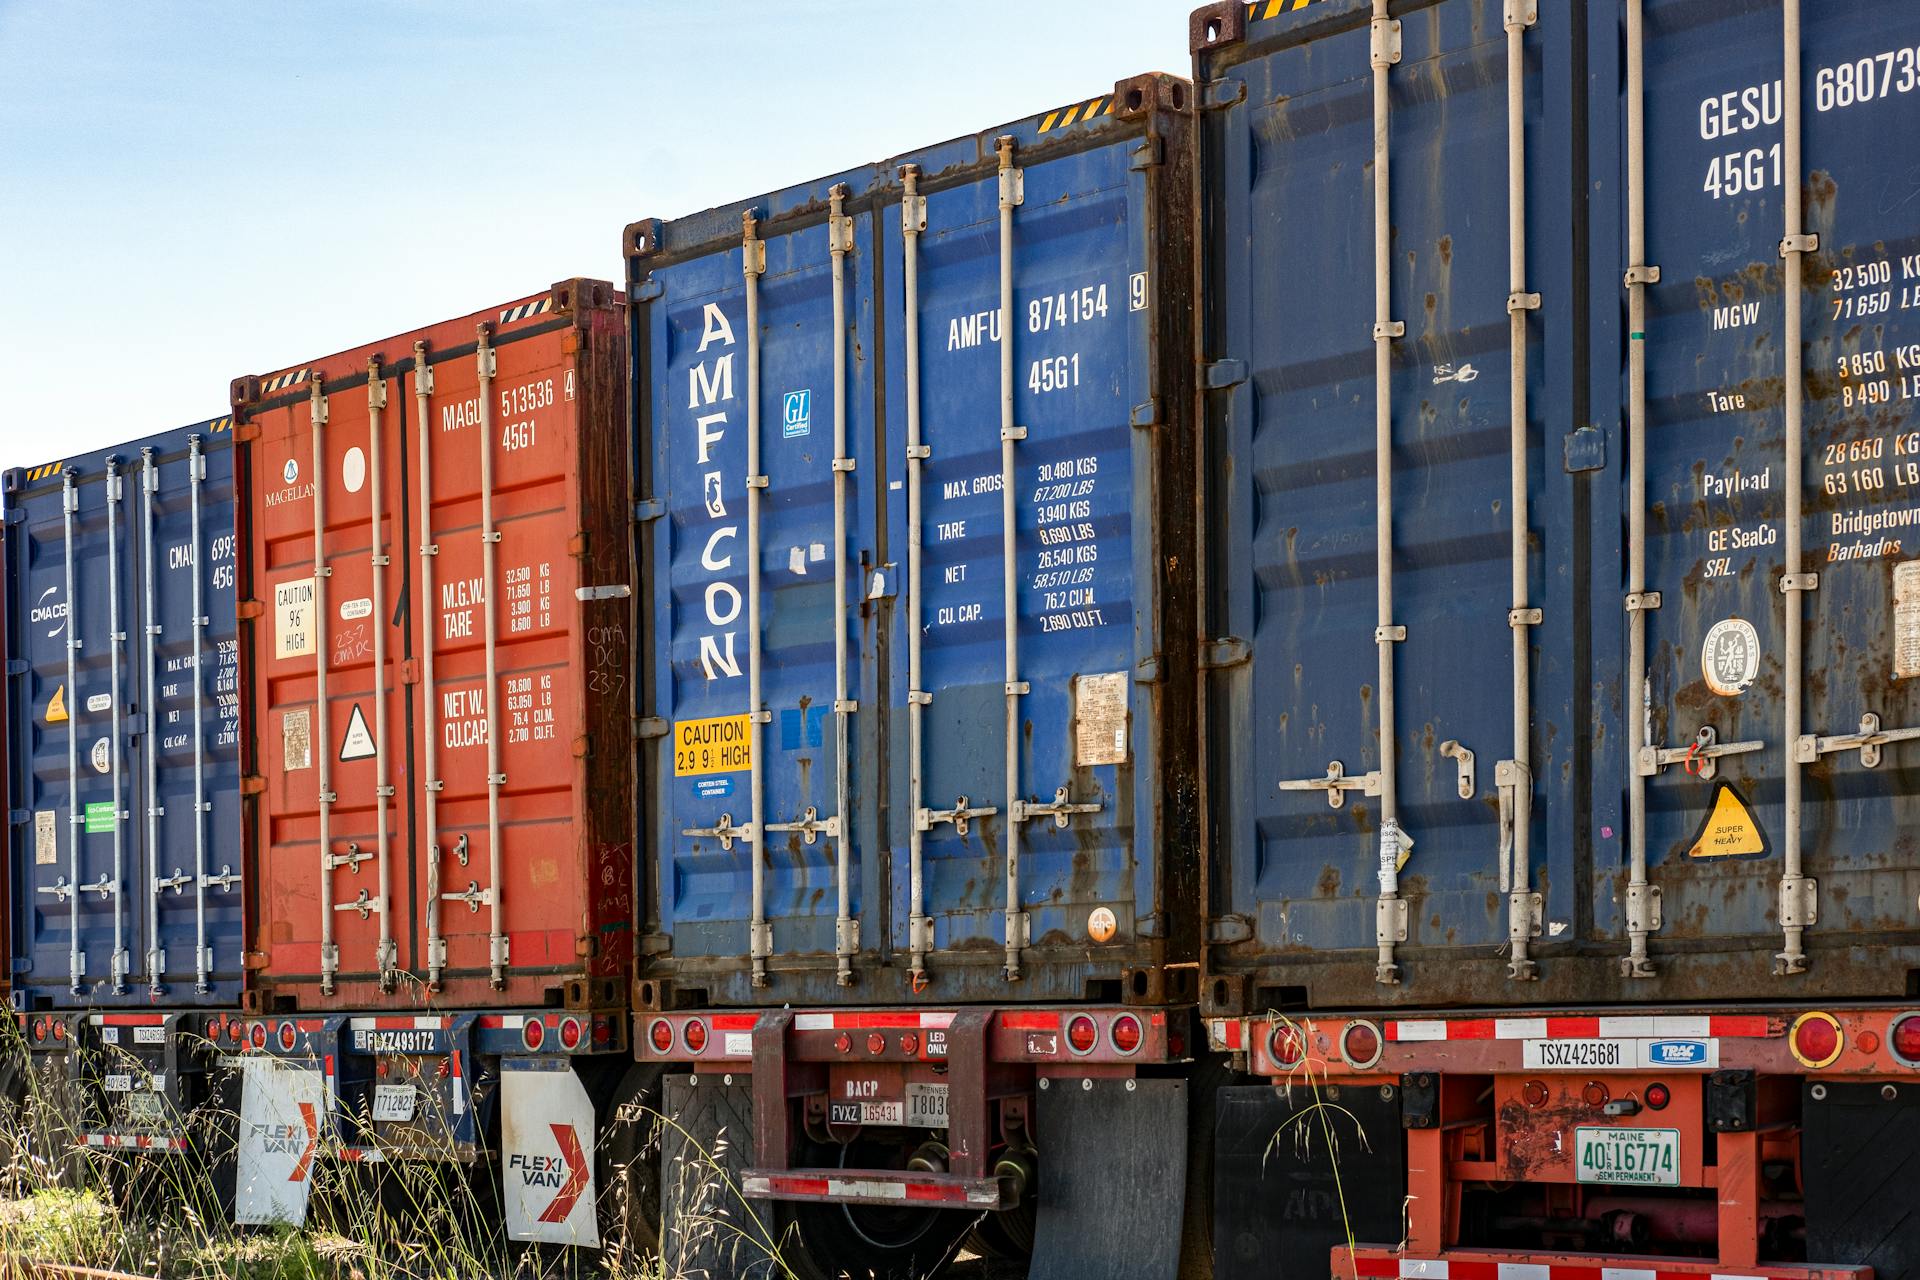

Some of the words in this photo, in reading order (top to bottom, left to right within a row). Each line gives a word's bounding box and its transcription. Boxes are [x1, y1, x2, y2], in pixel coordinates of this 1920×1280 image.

[1700, 79, 1782, 140] GESU
[1816, 47, 1920, 112] 68073
[1704, 143, 1781, 199] 45G1
[948, 309, 1002, 351] AMFU
[1029, 284, 1108, 333] 874154
[1132, 274, 1146, 309] 9
[1713, 302, 1760, 330] MGW
[1029, 353, 1079, 394] 45G1
[442, 397, 482, 432] MAGU
[501, 379, 553, 417] 513536
[565, 371, 575, 398] 4
[786, 393, 808, 423] GL
[1707, 391, 1745, 413] Tare
[502, 419, 536, 451] 45G1
[1895, 432, 1920, 456] KG
[1076, 457, 1097, 475] KGS
[1895, 462, 1920, 486] LB
[265, 482, 316, 507] MAGELLAN
[944, 480, 971, 500] MAX.
[1071, 479, 1095, 496] LBS
[1069, 500, 1090, 519] KGS
[938, 521, 966, 540] TARE
[1071, 522, 1095, 541] LBS
[1832, 508, 1920, 536] Bridgetown
[1709, 529, 1728, 552] GE
[1731, 524, 1777, 549] SeaCo
[169, 543, 194, 569] CMAU
[1076, 545, 1097, 563] KGS
[1827, 536, 1901, 562] Barbados
[506, 566, 530, 584] 32.500
[539, 563, 550, 577] KG
[945, 565, 967, 583] NET
[1071, 567, 1094, 584] LBS
[1704, 557, 1736, 578] SRL.
[213, 565, 236, 590] 45G
[278, 584, 312, 607] CAUTION
[443, 577, 485, 609] M.G.W.
[506, 583, 530, 600] 71.650
[540, 579, 550, 594] LB
[52, 602, 68, 619] CG
[511, 600, 531, 616] 3.900
[540, 596, 550, 611] KG
[1044, 592, 1066, 610] 76.2
[443, 610, 473, 640] TARE
[540, 612, 550, 627] LB
[286, 632, 305, 651] HIGH
[1707, 624, 1729, 661] BUREAU
[1733, 623, 1755, 657] VERITAS
[167, 658, 182, 672] MAX.
[163, 683, 178, 697] TARE
[507, 678, 531, 694] 28.600
[541, 675, 551, 689] KG
[444, 691, 466, 719] NET
[468, 689, 484, 716] W.
[508, 694, 532, 711] 63.050
[541, 692, 551, 706] LB
[168, 710, 180, 723] NET
[513, 710, 529, 725] 76.4
[509, 728, 529, 743] 2.700
[683, 721, 744, 746] CAUTION
[721, 745, 751, 766] HIGH
[1716, 825, 1744, 834] SUPER
[1714, 836, 1743, 845] HEAVY
[367, 1031, 434, 1051] FLXZ493172
[930, 1032, 945, 1042] LED
[927, 1043, 948, 1054] ONLY
[1539, 1043, 1620, 1065] TSXZ425681
[1661, 1044, 1695, 1057] TRAC
[846, 1080, 879, 1098] BACP
[832, 1105, 857, 1121] FVXZ
[864, 1105, 897, 1121] 165431
[250, 1124, 302, 1140] FLEXI
[1608, 1132, 1645, 1141] MAINE
[264, 1139, 300, 1155] VAN
[509, 1154, 562, 1173] FLEXI
[522, 1170, 561, 1188] VAN
[1615, 1171, 1655, 1182] PERMANENT
